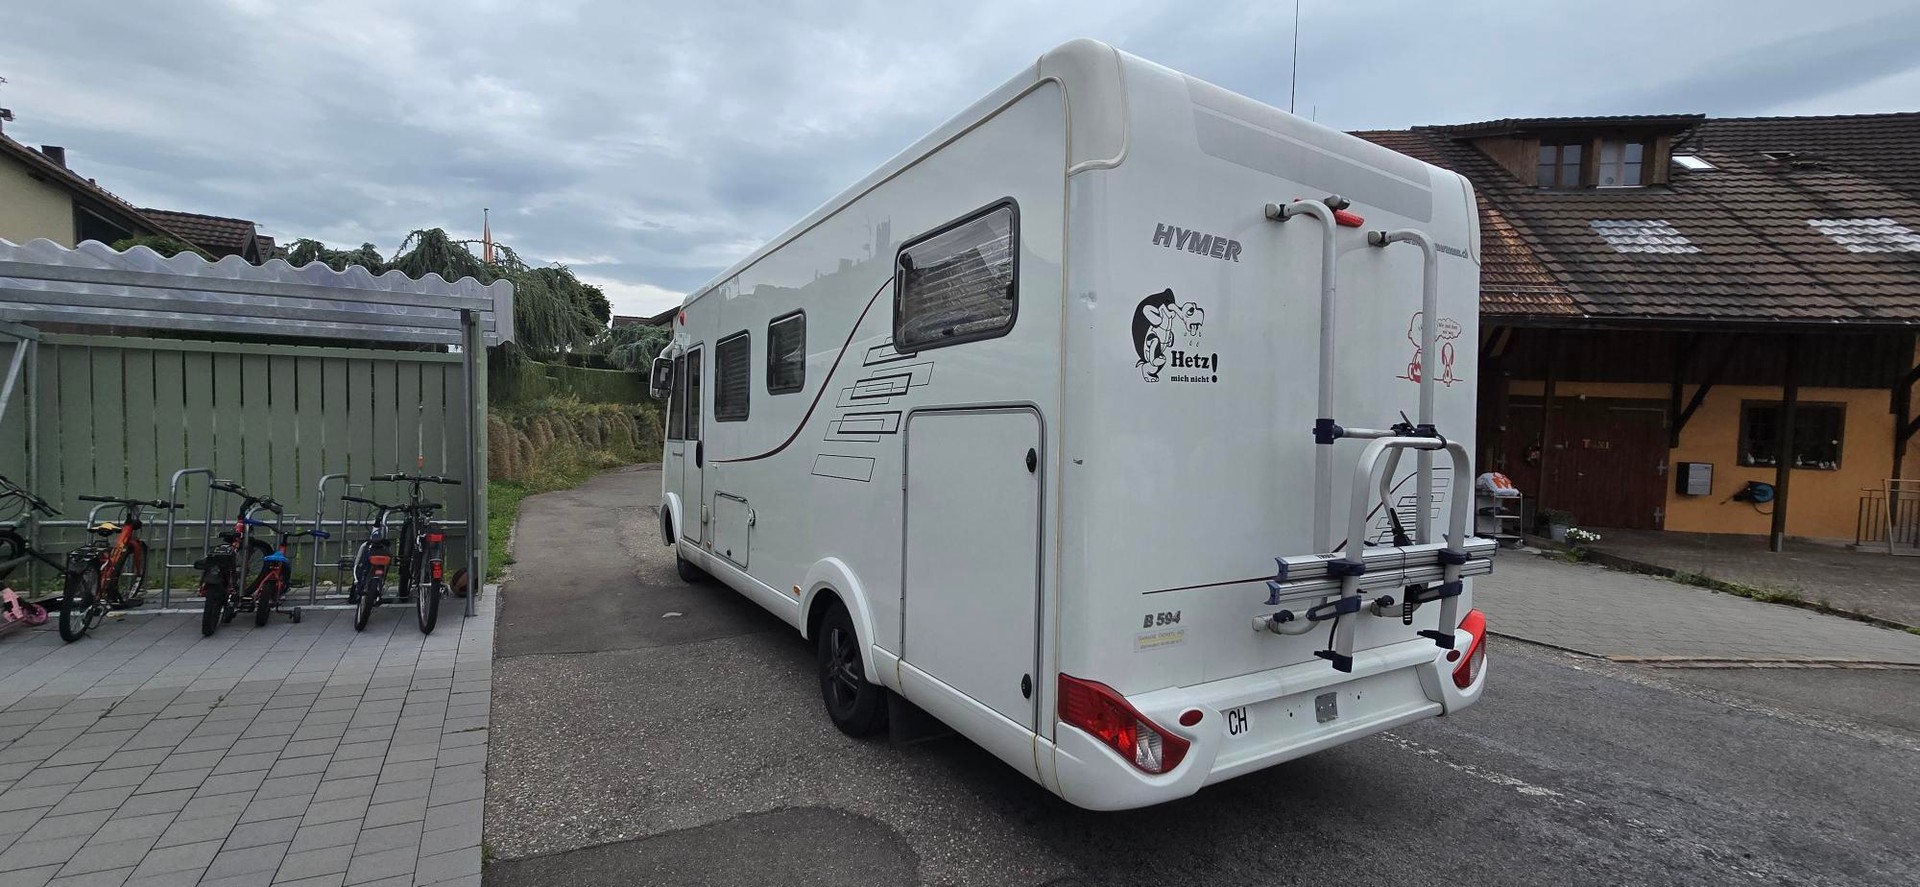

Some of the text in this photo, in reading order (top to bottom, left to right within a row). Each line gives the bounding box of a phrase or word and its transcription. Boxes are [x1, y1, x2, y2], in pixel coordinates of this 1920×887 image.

[1152, 222, 1242, 262] HYMER
[1143, 610, 1181, 628] B 594
[1228, 706, 1248, 735] CH
